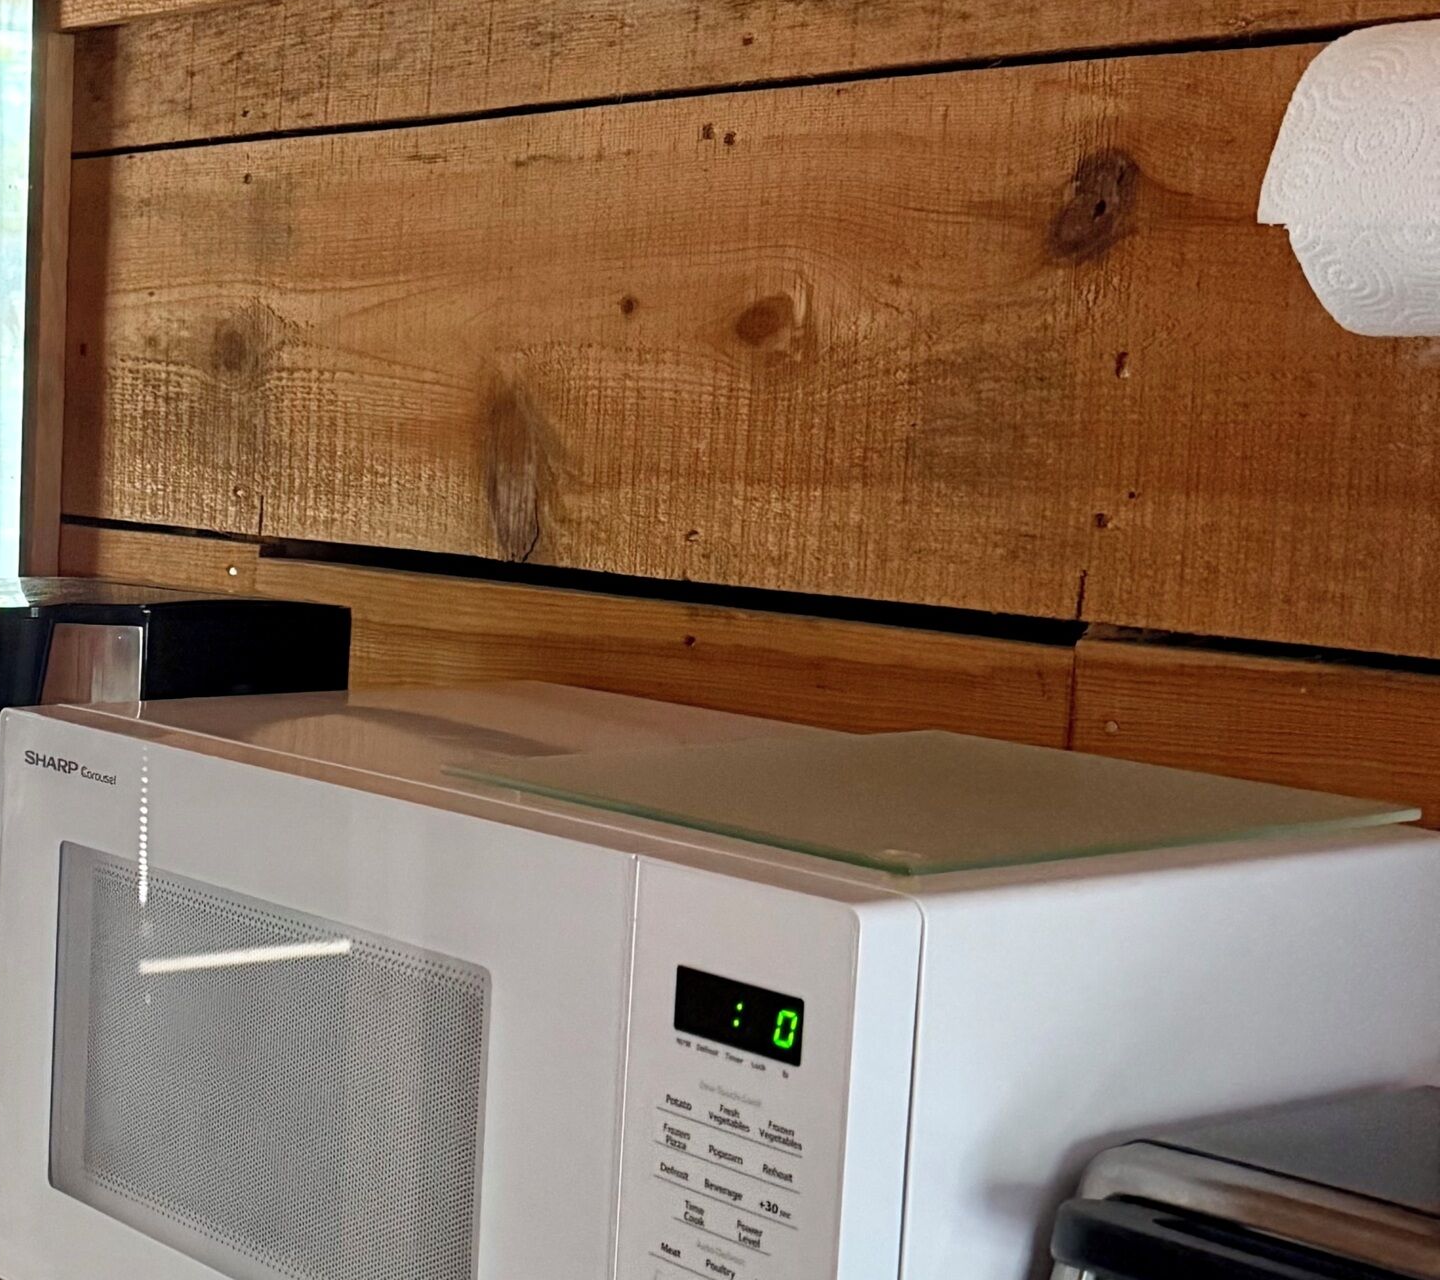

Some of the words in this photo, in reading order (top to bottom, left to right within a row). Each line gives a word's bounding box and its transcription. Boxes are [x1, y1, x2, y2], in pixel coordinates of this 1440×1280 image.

[24, 750, 79, 774] SHARP
[81, 766, 117, 785] Carousel
[665, 1093, 693, 1111] Potato
[719, 1104, 740, 1118] Fresh
[708, 1111, 750, 1132] Vegetables
[768, 1120, 795, 1137] Frozen
[663, 1123, 691, 1141] Frozen
[759, 1127, 803, 1151] Vegetables
[666, 1134, 687, 1151] Pizza
[708, 1144, 743, 1165] Popcorn
[660, 1162, 689, 1181] Defrost
[762, 1163, 793, 1183] Reheat
[704, 1178, 743, 1201] Beverage
[684, 1200, 705, 1216] Time
[759, 1200, 779, 1214] +30
[683, 1211, 705, 1227] Cook
[737, 1219, 763, 1237] Power
[738, 1232, 761, 1249] Level
[661, 1242, 681, 1258] Meat
[705, 1258, 735, 1280] Poultry
